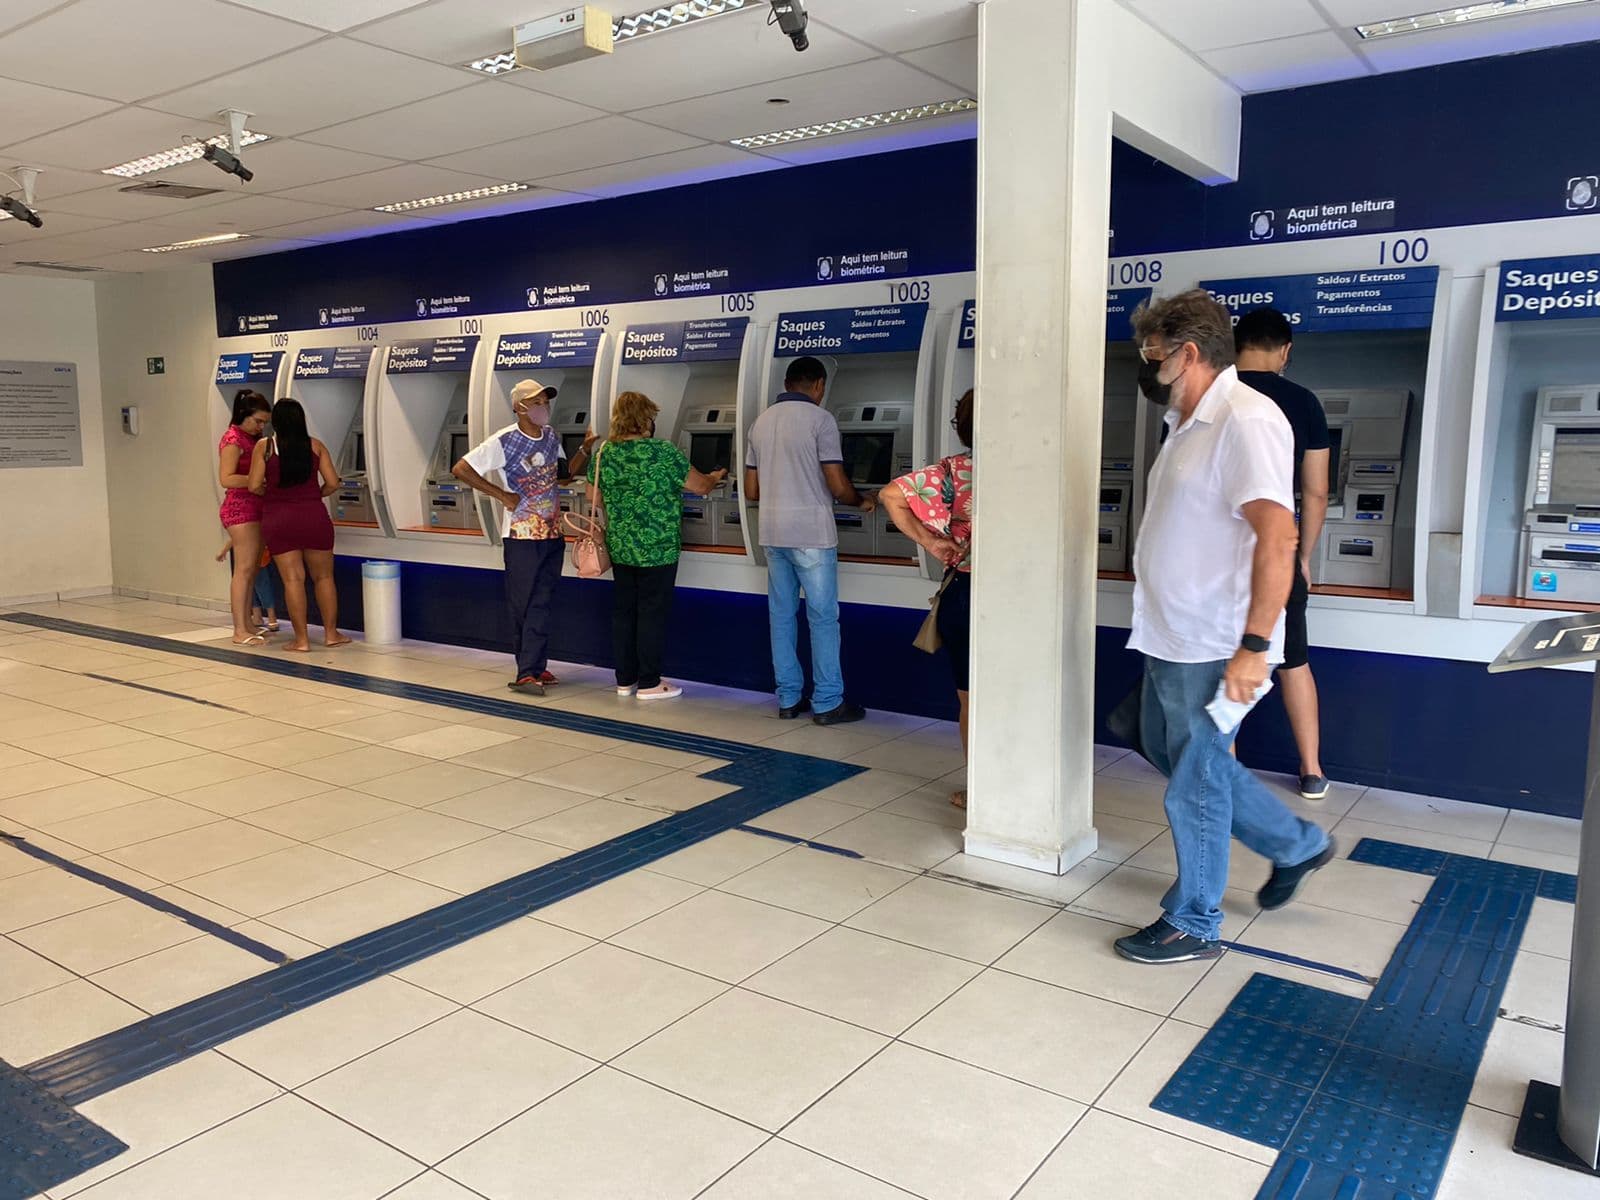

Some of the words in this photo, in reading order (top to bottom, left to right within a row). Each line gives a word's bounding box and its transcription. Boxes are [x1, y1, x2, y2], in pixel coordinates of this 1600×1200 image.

[1287, 205, 1318, 221] Aqui
[1322, 204, 1347, 215] tem
[1351, 199, 1395, 213] leitura
[1287, 217, 1357, 234] biométrica
[840, 253, 860, 266] Aqui
[862, 252, 878, 262] tem
[880, 249, 908, 260] leitura
[1380, 237, 1428, 265] 100
[673, 272, 690, 283] Aqui
[691, 271, 704, 280] tem
[706, 269, 729, 278] leitura
[840, 264, 885, 277] biométrica
[1110, 260, 1162, 286] 1008
[1317, 275, 1350, 285] Saldos
[1359, 272, 1405, 283] Extratos
[1505, 269, 1598, 291] Saques
[673, 282, 711, 293] biométrica
[889, 281, 930, 303] 1003
[1316, 289, 1381, 301] Pagamentos
[721, 293, 755, 313] 1005
[1317, 303, 1392, 314] Transferências
[580, 309, 610, 327] 1006
[854, 306, 901, 317] Transferências
[459, 319, 483, 334] 1001
[780, 319, 825, 335] Saques
[851, 320, 872, 328] Saldos
[877, 318, 906, 327] Extratos
[270, 333, 289, 347] 1009
[357, 327, 378, 341] 1004
[626, 331, 665, 346] Saques
[850, 330, 890, 340] Pagamentos
[500, 340, 531, 353] Saques
[778, 335, 842, 351] Depósitos
[299, 353, 323, 365] Saques
[391, 346, 419, 358] Saques
[625, 345, 678, 361] Depósitos
[389, 357, 428, 370] Depósitos
[496, 353, 541, 367] Depósitos
[296, 364, 329, 377] Depósitos
